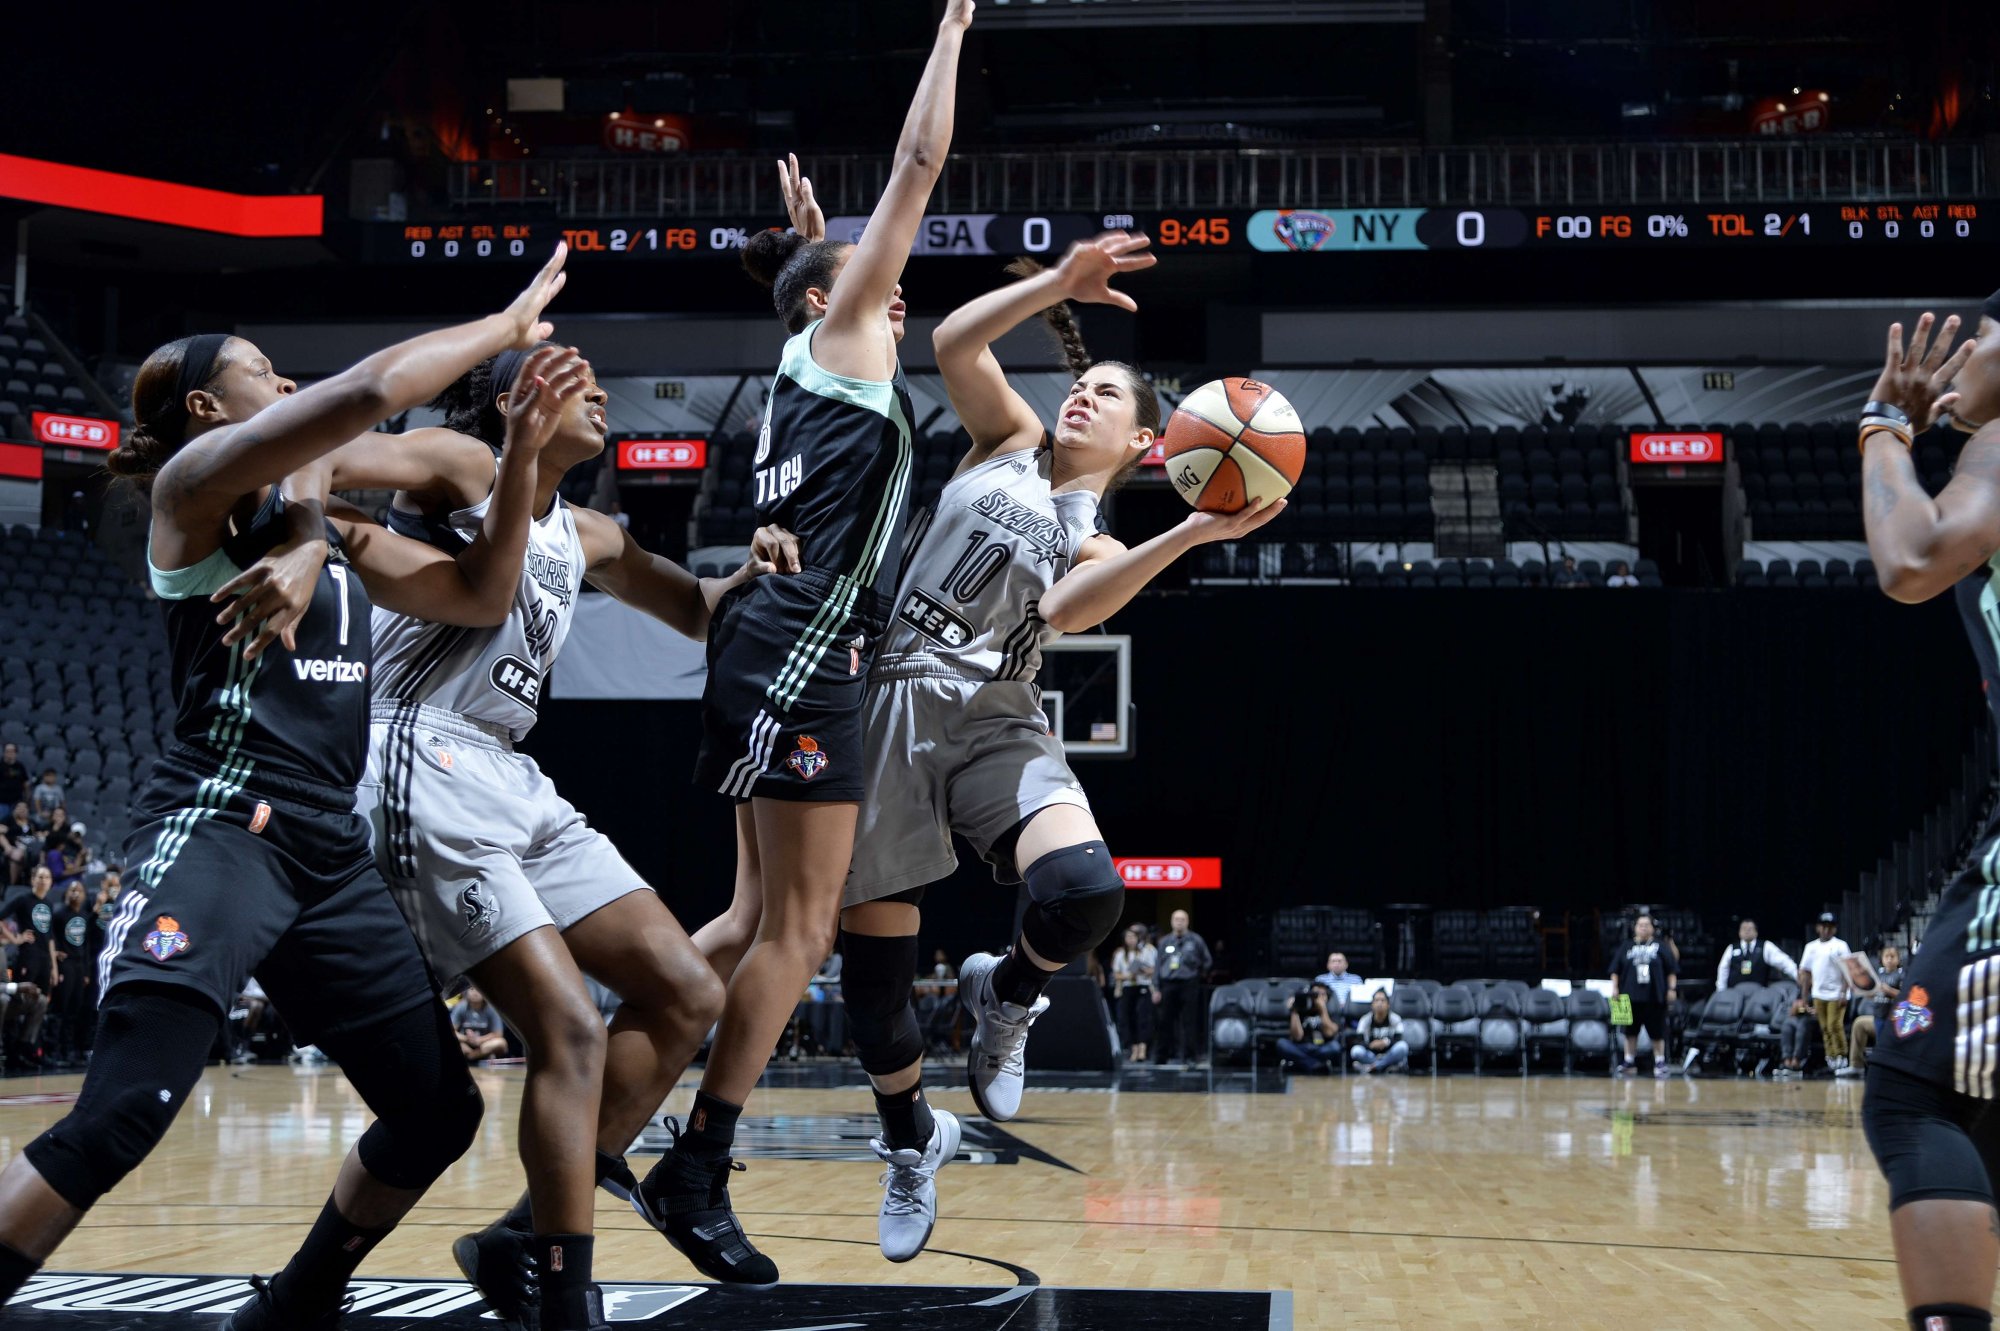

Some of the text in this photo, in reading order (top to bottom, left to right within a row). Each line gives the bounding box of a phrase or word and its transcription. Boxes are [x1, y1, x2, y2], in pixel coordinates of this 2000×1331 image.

[1536, 216, 1550, 238] F
[1556, 216, 1592, 238] 00
[1600, 216, 1632, 238] FG
[1647, 215, 1689, 238] 0%
[1708, 214, 1754, 236] TOL
[1841, 204, 1977, 220] BLK STL AST REB
[405, 225, 531, 240] REB AST STL BLK
[562, 229, 607, 251] TOL
[666, 229, 697, 250] FG
[710, 228, 751, 249] 0%
[927, 217, 1052, 252] SA 0
[1160, 218, 1230, 246] 9:45
[1352, 211, 1485, 246] NY 0
[1849, 220, 1970, 238] 0 0 0 0
[411, 240, 524, 257] 0 0 0 0
[971, 488, 1068, 549] STARS
[939, 530, 1011, 603] 10
[328, 563, 350, 645] 1
[294, 655, 367, 683] verizo
